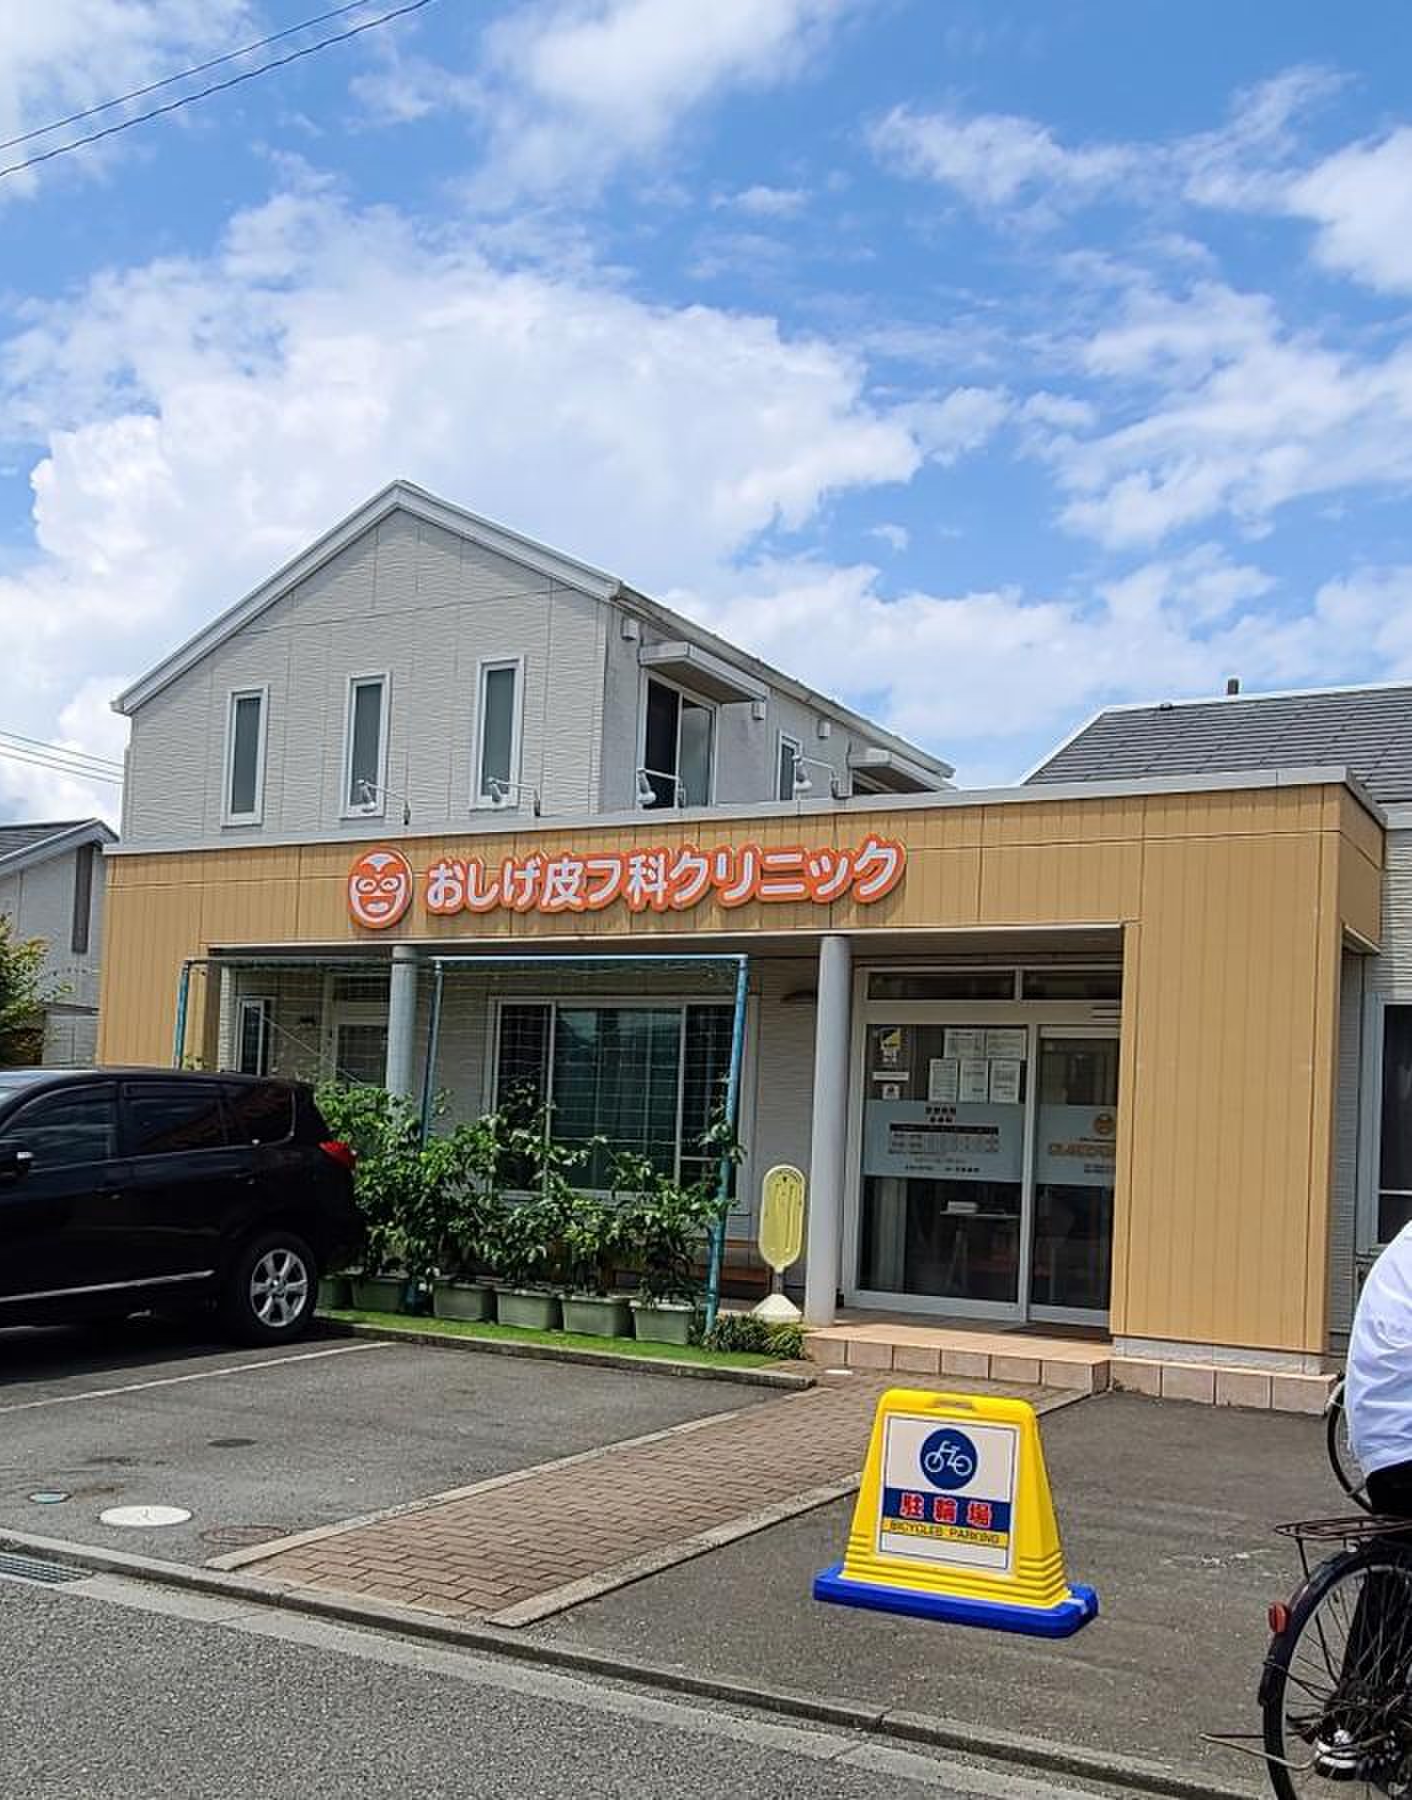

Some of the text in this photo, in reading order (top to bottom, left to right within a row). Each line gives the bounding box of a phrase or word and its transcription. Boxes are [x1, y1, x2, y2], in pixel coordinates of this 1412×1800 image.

[426, 836, 907, 914] おしげ皮フ科クリニック
[899, 1492, 993, 1527] 駐輪場
[948, 1527, 1000, 1544] PARKING
